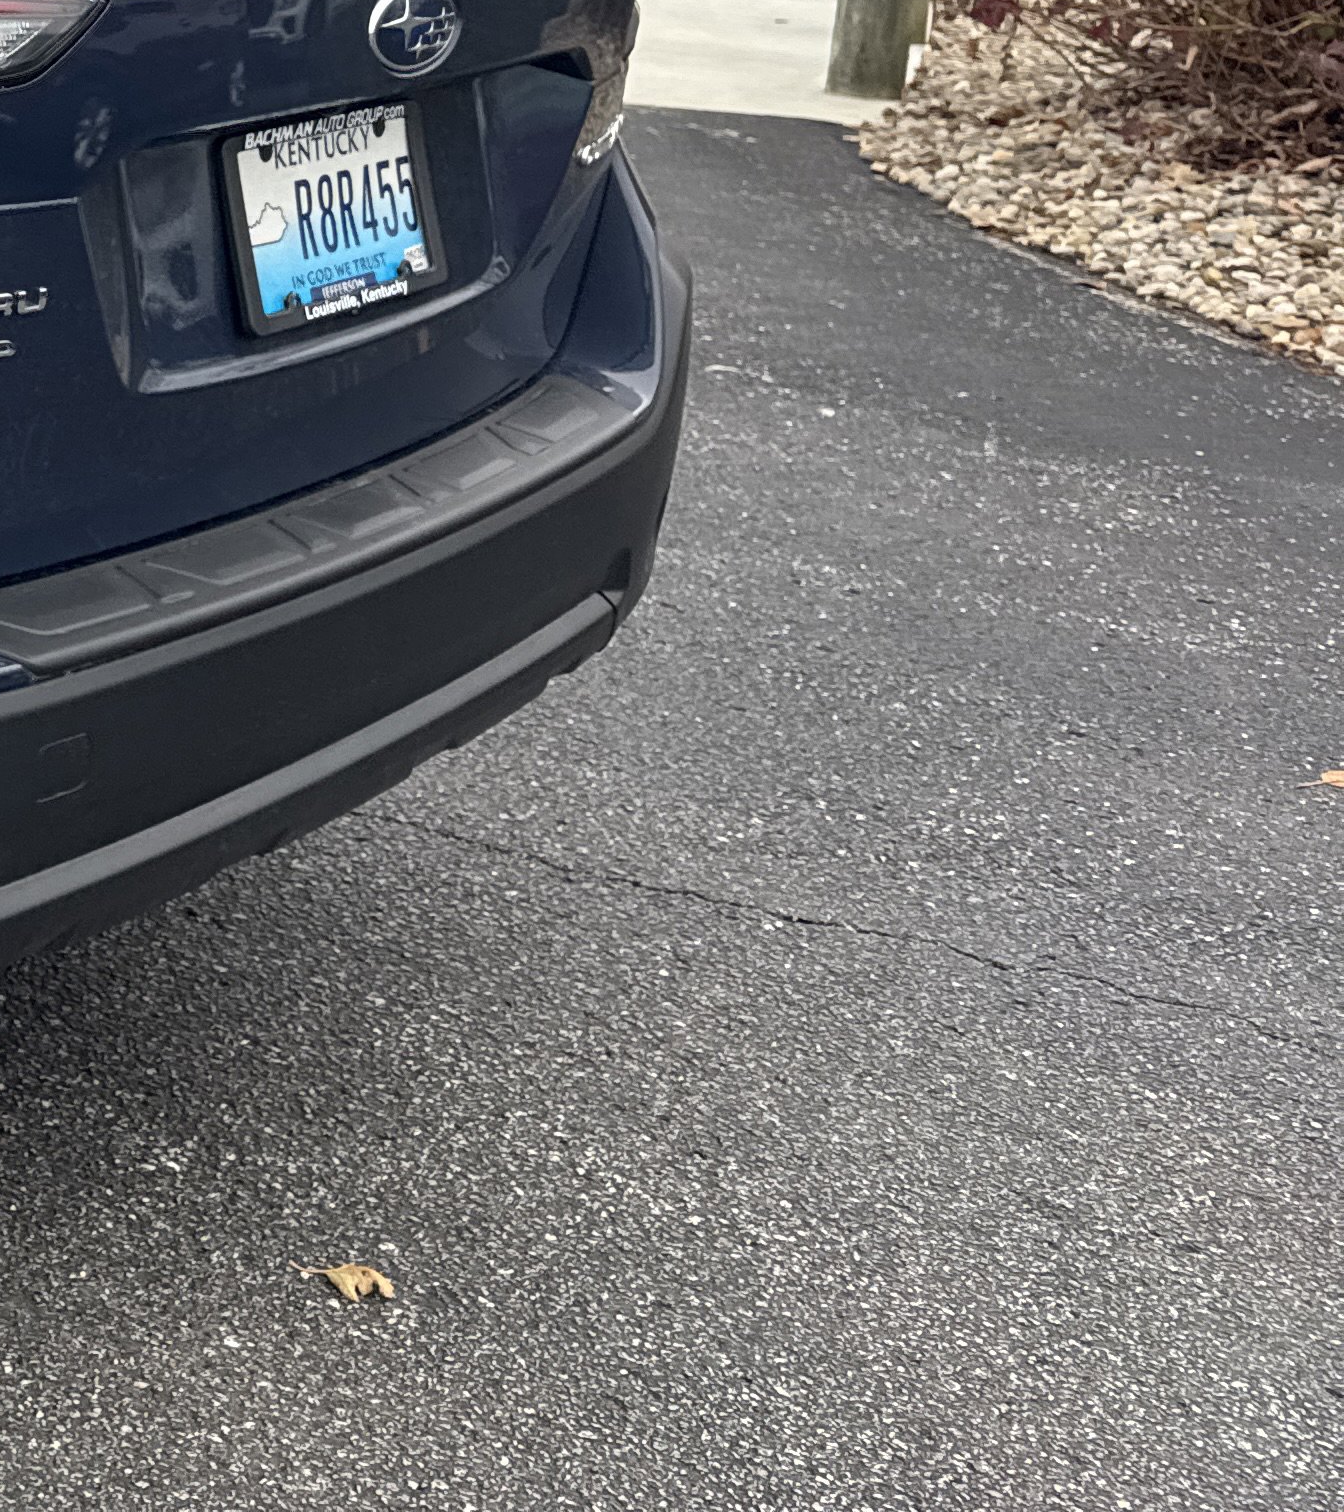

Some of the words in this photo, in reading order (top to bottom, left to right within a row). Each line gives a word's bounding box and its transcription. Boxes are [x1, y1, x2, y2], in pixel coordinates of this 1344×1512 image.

[244, 120, 315, 150] BACHMAN
[314, 114, 346, 134] AUTO
[274, 125, 370, 170] KENTUCKY
[294, 155, 419, 260] R8R455
[291, 275, 305, 289] IN
[306, 266, 333, 286] GOD
[333, 261, 352, 278] WE
[352, 252, 387, 273] TRUST
[322, 277, 367, 299] JEFFERSON
[304, 294, 361, 320] Louisville,
[360, 279, 408, 304] Kentucky
